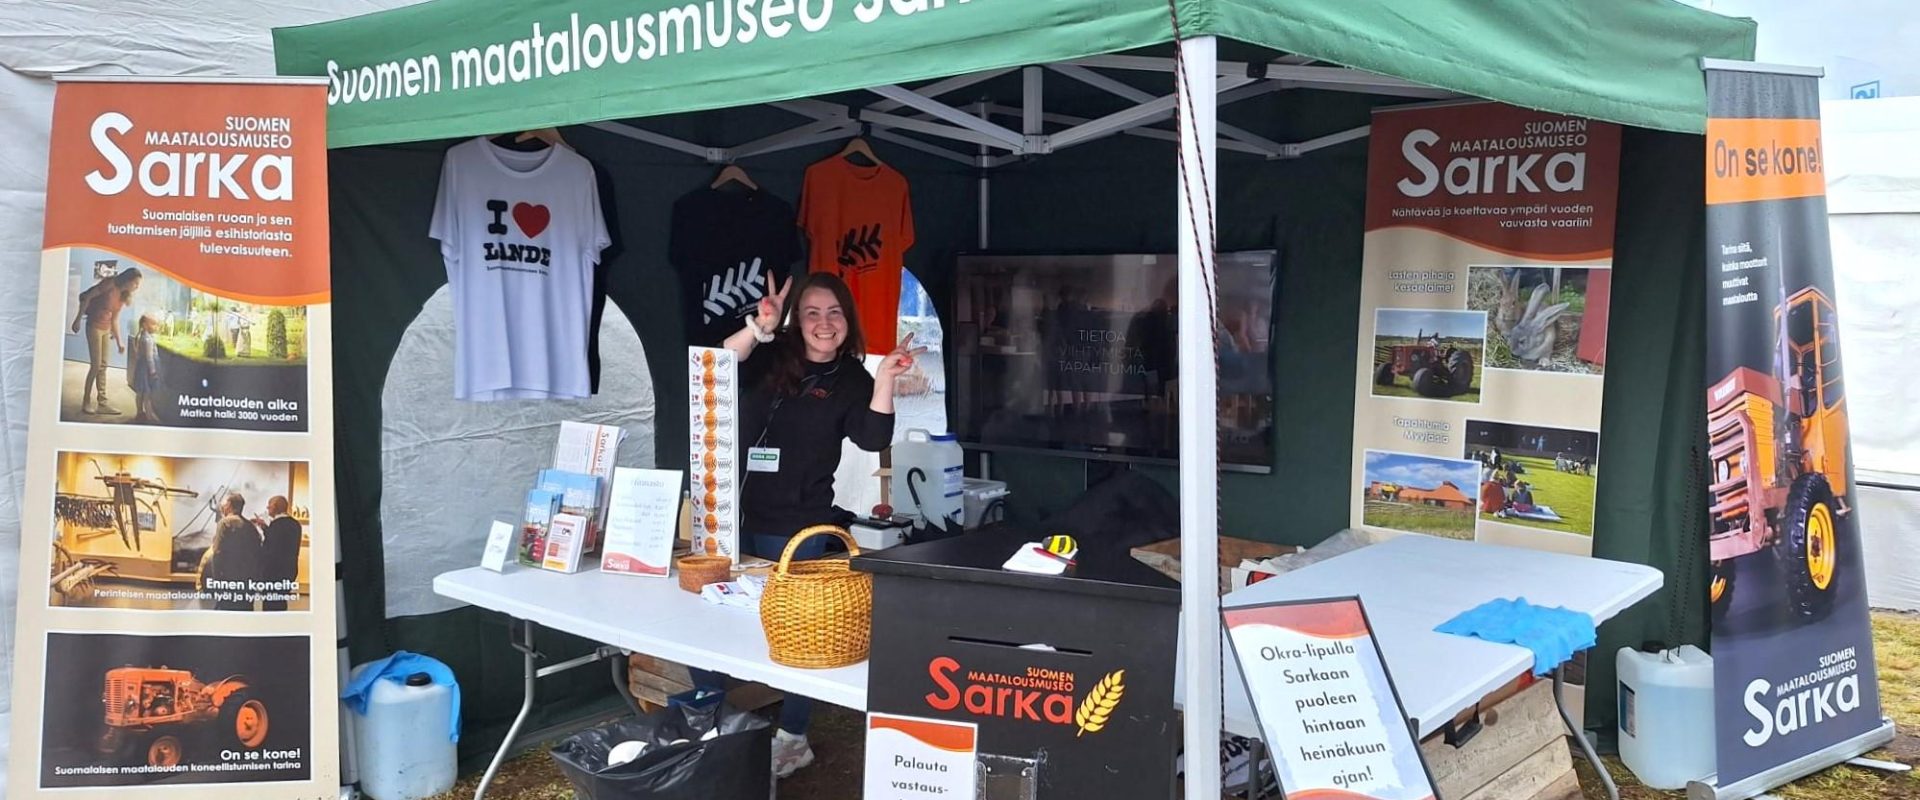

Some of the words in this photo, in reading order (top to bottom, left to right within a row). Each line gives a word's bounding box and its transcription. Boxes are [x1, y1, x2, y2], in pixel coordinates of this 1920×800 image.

[326, 59, 440, 106] Suomen
[450, 0, 833, 90] maatalousmuseo
[225, 116, 290, 132] SUOMEN
[1524, 119, 1588, 135] SUOMEN
[144, 131, 292, 149] MAATALOUSMUSEO
[1449, 133, 1588, 153] MAATALOUSMUSEO
[1714, 139, 1739, 179] On
[1745, 148, 1768, 177] se
[1773, 138, 1822, 176] kone!
[142, 208, 214, 222] Suomalaisen
[217, 212, 254, 224] ruoan
[256, 213, 267, 227] ja
[270, 215, 292, 226] sen
[486, 199, 508, 236] I
[1392, 207, 1441, 217] Nähtävää
[1442, 207, 1451, 218] ja
[1454, 206, 1507, 216] koettavaa
[1509, 204, 1548, 217] ympäri
[1550, 204, 1594, 214] vuoden
[1500, 218, 1548, 228] vauvasta
[1551, 217, 1593, 228] vaariin!
[107, 223, 177, 236] tuottamisen
[179, 226, 212, 240] jäljillä
[215, 227, 293, 242] esihistoriasta
[200, 242, 293, 257] tulevaisuuteen.
[1077, 329, 1126, 343] TIETOA
[1058, 360, 1147, 375] TAPAHTUMIA
[178, 395, 264, 410] Maatalouden
[267, 398, 298, 410] aika
[180, 409, 212, 418] Matka
[214, 409, 236, 419] halki
[238, 411, 258, 420] 3000
[260, 412, 299, 421] vuoden
[206, 578, 245, 590] Ennen
[248, 578, 300, 591] koneita
[94, 589, 144, 599] Perinteisen
[146, 590, 212, 600] maatalouden
[214, 591, 232, 602] työt
[233, 592, 243, 602] ja
[245, 592, 300, 603] työvälineet
[1260, 640, 1355, 662] Okra-lipulla
[1819, 646, 1856, 668] SUOMEN
[967, 671, 1074, 692] MAATALOUSMUSEO
[1026, 666, 1074, 682] SUOMEN
[1283, 667, 1350, 684] Sarkaan
[1776, 659, 1857, 698] MAATALOUSMUSEO
[1295, 691, 1357, 713] puoleen
[1302, 717, 1366, 734] hintaan
[220, 750, 240, 761] On
[244, 751, 259, 760] se
[263, 748, 301, 760] kone!
[1300, 740, 1386, 761] heinäkuun
[54, 765, 119, 775] Suomalaisen
[121, 763, 189, 774] maatalouden
[191, 761, 271, 772] koneellistumisen
[273, 760, 301, 770] tarina
[894, 754, 948, 772] Palauta
[1332, 765, 1375, 789] ajan!
[891, 780, 949, 794] vastaus-
